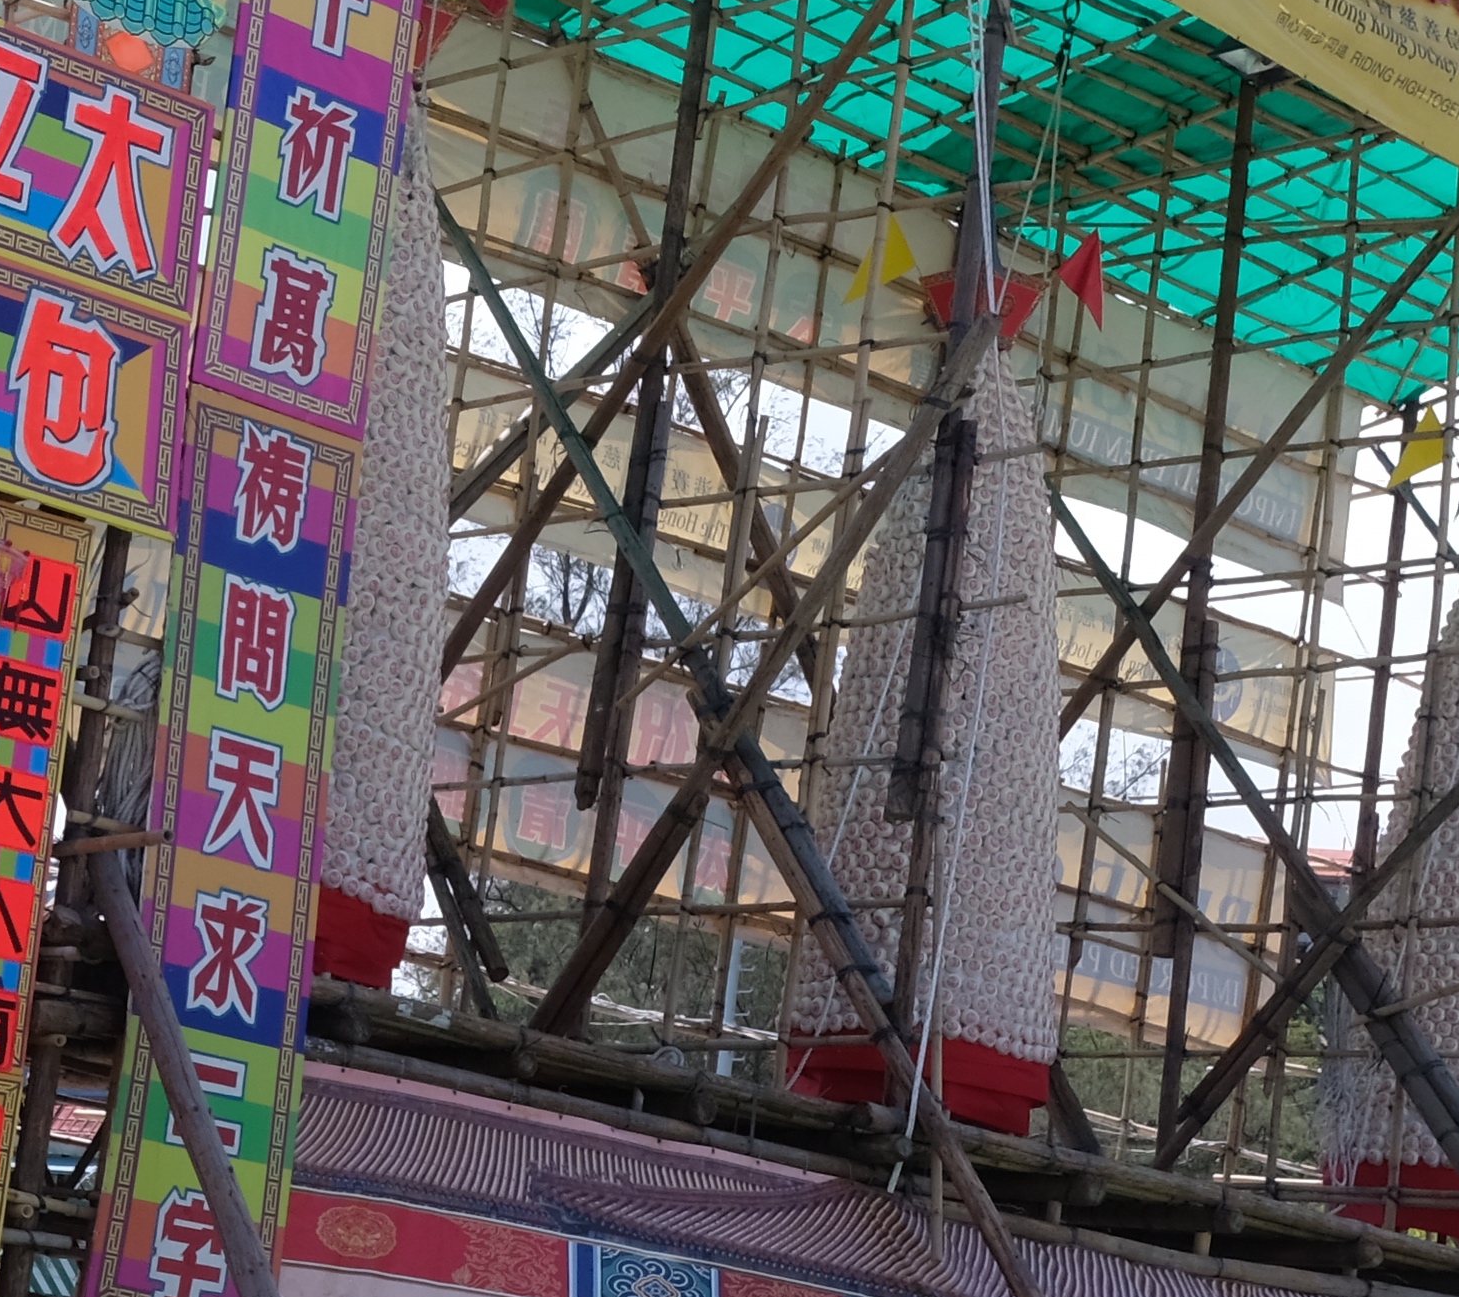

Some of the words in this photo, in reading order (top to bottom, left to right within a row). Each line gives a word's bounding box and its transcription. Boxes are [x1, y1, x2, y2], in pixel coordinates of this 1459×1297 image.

[1369, 11, 1411, 56] Kong
[1349, 49, 1396, 85] RIDING
[1393, 71, 1425, 100] HIGH
[9, 286, 123, 491] 包
